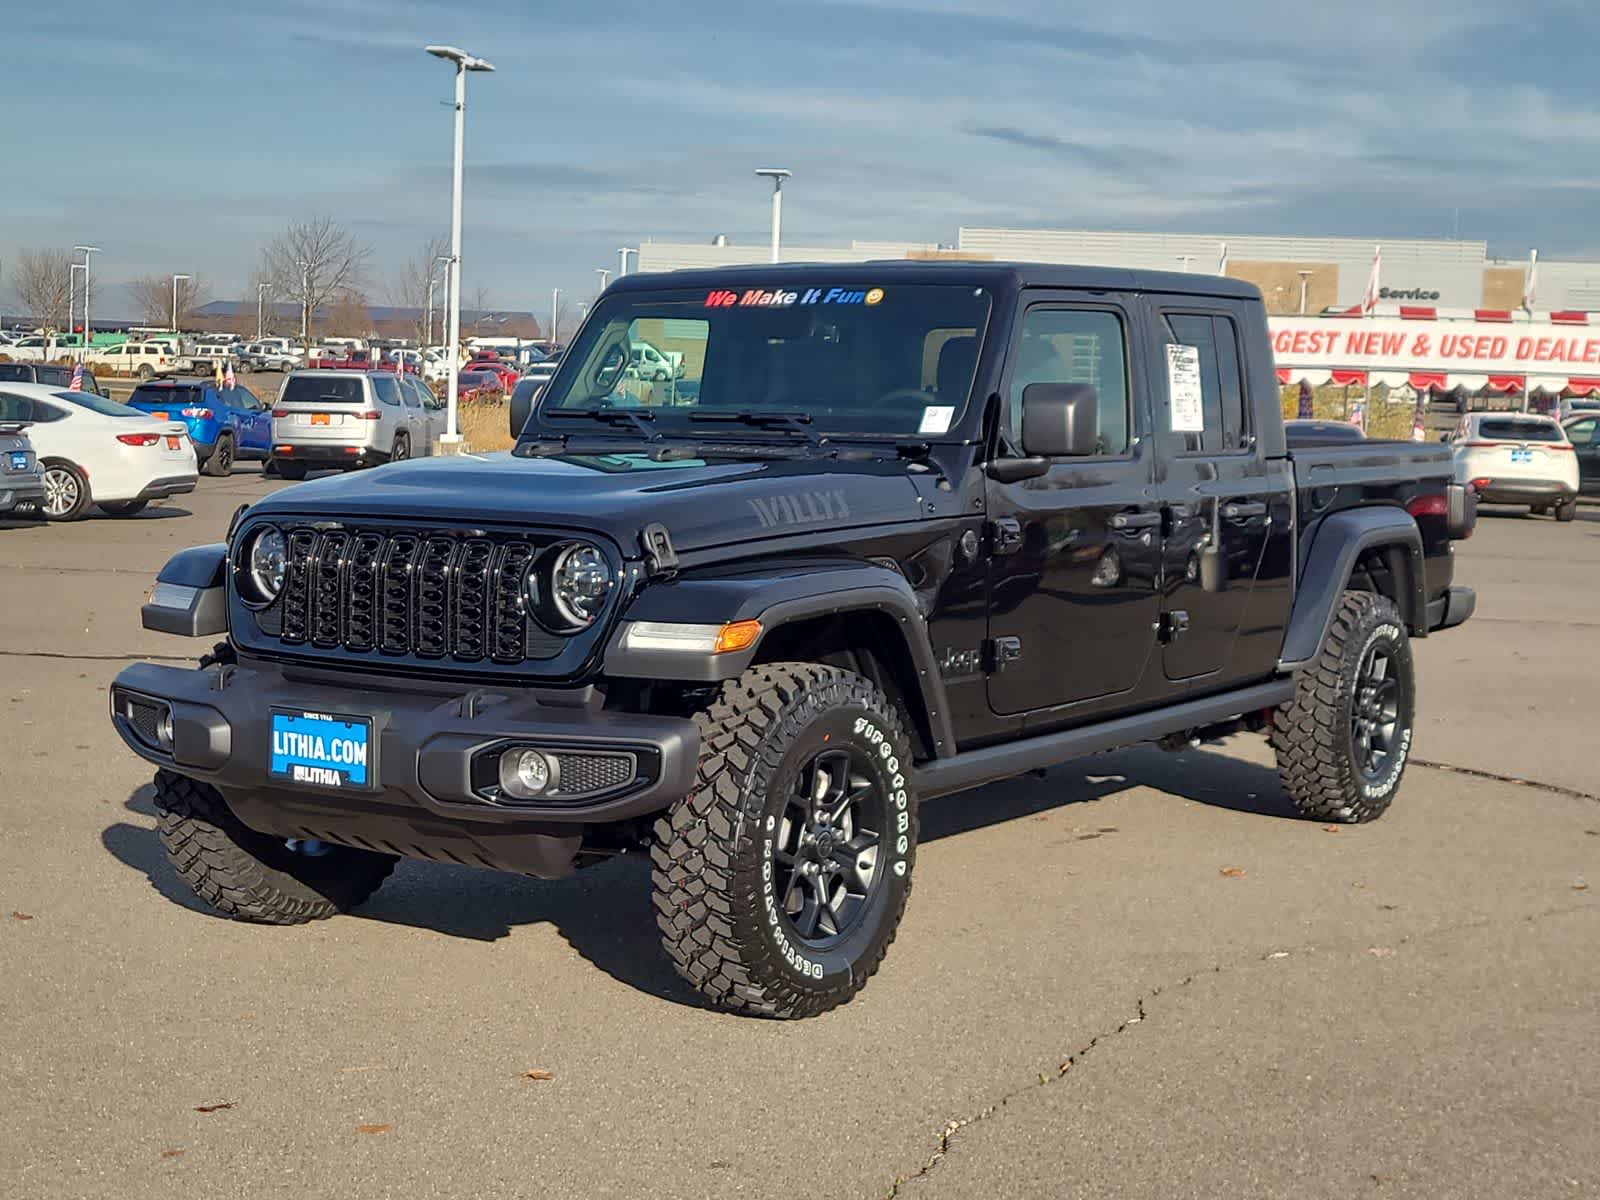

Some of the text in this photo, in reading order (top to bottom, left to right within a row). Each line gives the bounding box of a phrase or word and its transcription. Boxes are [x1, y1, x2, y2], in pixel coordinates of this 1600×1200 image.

[704, 287, 866, 307] We Make It Fun
[1379, 286, 1440, 300] Service
[1344, 331, 1407, 356] NEW
[1411, 332, 1431, 357] &
[1439, 334, 1508, 360] USED
[1514, 336, 1600, 363] DEALE
[746, 490, 850, 527] WILLYS
[940, 647, 980, 673] Jeep
[273, 730, 367, 767] LITHIA.COM
[305, 766, 341, 786] LITHIA
[762, 839, 824, 980] DESTINATION
